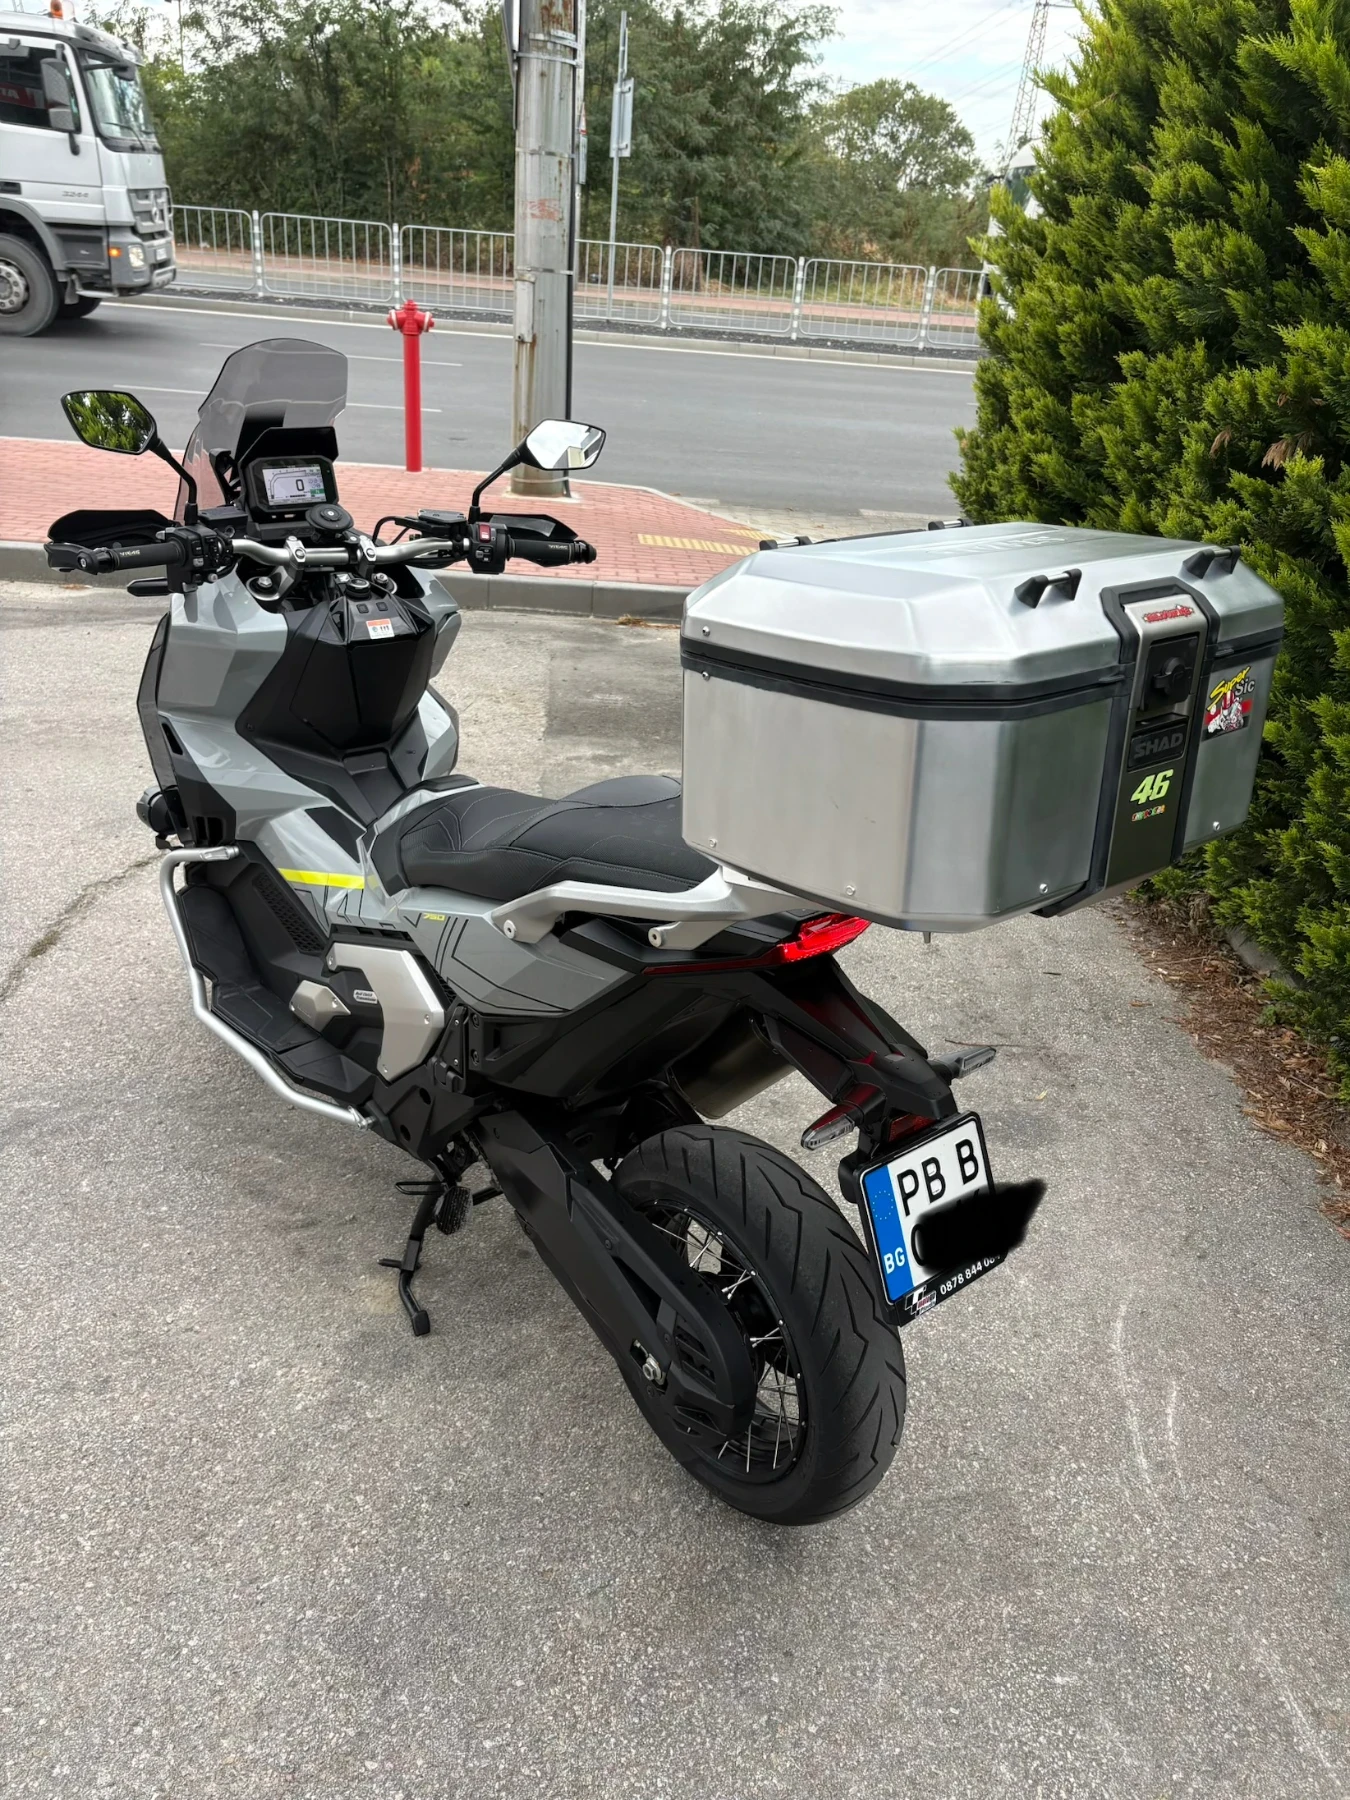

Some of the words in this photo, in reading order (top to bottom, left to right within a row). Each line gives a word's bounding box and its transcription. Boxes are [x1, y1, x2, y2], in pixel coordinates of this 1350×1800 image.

[296, 479, 305, 491] 0
[1206, 666, 1251, 711] Super
[1235, 678, 1255, 695] Sic
[1133, 732, 1183, 759] SHAD
[1130, 769, 1174, 805] 46
[423, 912, 446, 921] 750
[897, 1156, 946, 1217] PB
[955, 1138, 979, 1186] B
[884, 1246, 906, 1274] BG
[939, 1273, 965, 1295] 0878
[965, 1262, 983, 1280] 844
